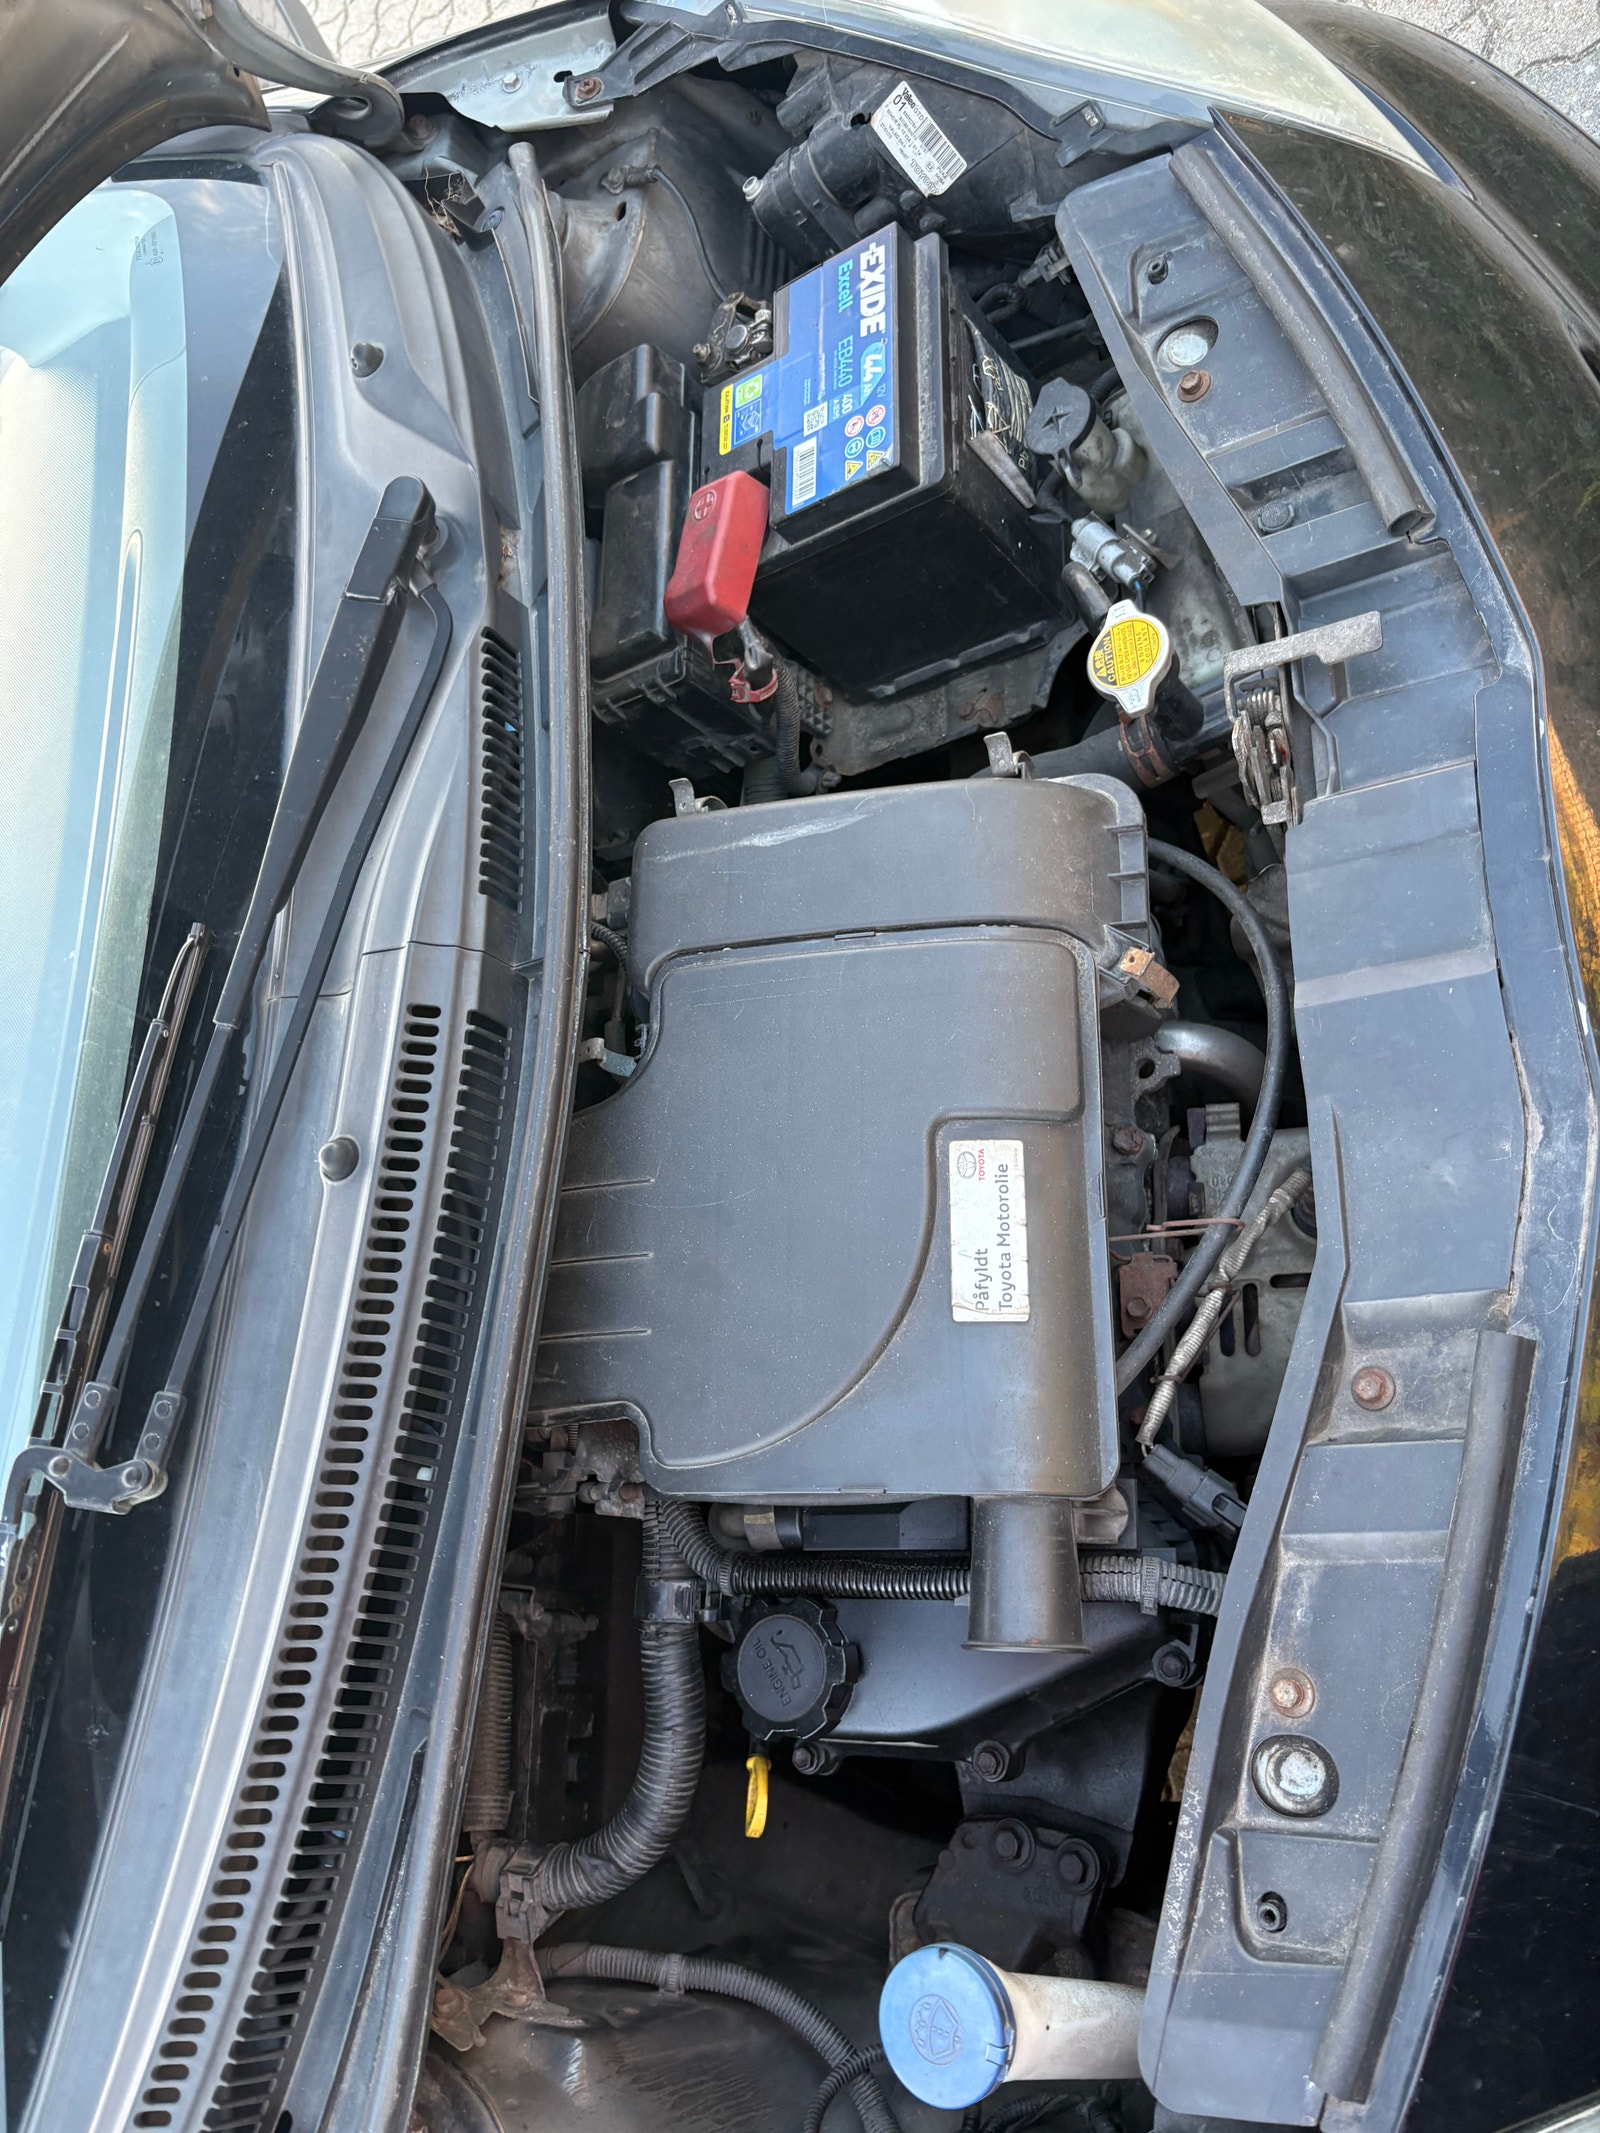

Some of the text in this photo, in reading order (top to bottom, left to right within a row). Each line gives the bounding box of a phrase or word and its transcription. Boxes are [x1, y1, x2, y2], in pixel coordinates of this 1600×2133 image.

[893, 94, 907, 112] 01
[902, 87, 915, 109] Valeo
[838, 259, 853, 313] Excell
[860, 242, 887, 338] EXIDE
[838, 335, 853, 388] EB440
[863, 353, 883, 382] 44
[841, 393, 853, 415] 400
[1103, 636, 1117, 683] CAUTION
[1135, 631, 1145, 663] ENGINE
[1141, 626, 1151, 663] COOLANT
[995, 1163, 1016, 1311] Toyota Motorolie
[973, 1248, 992, 1311] Påfyldt
[752, 1637, 792, 1707] ENGINE OIL
